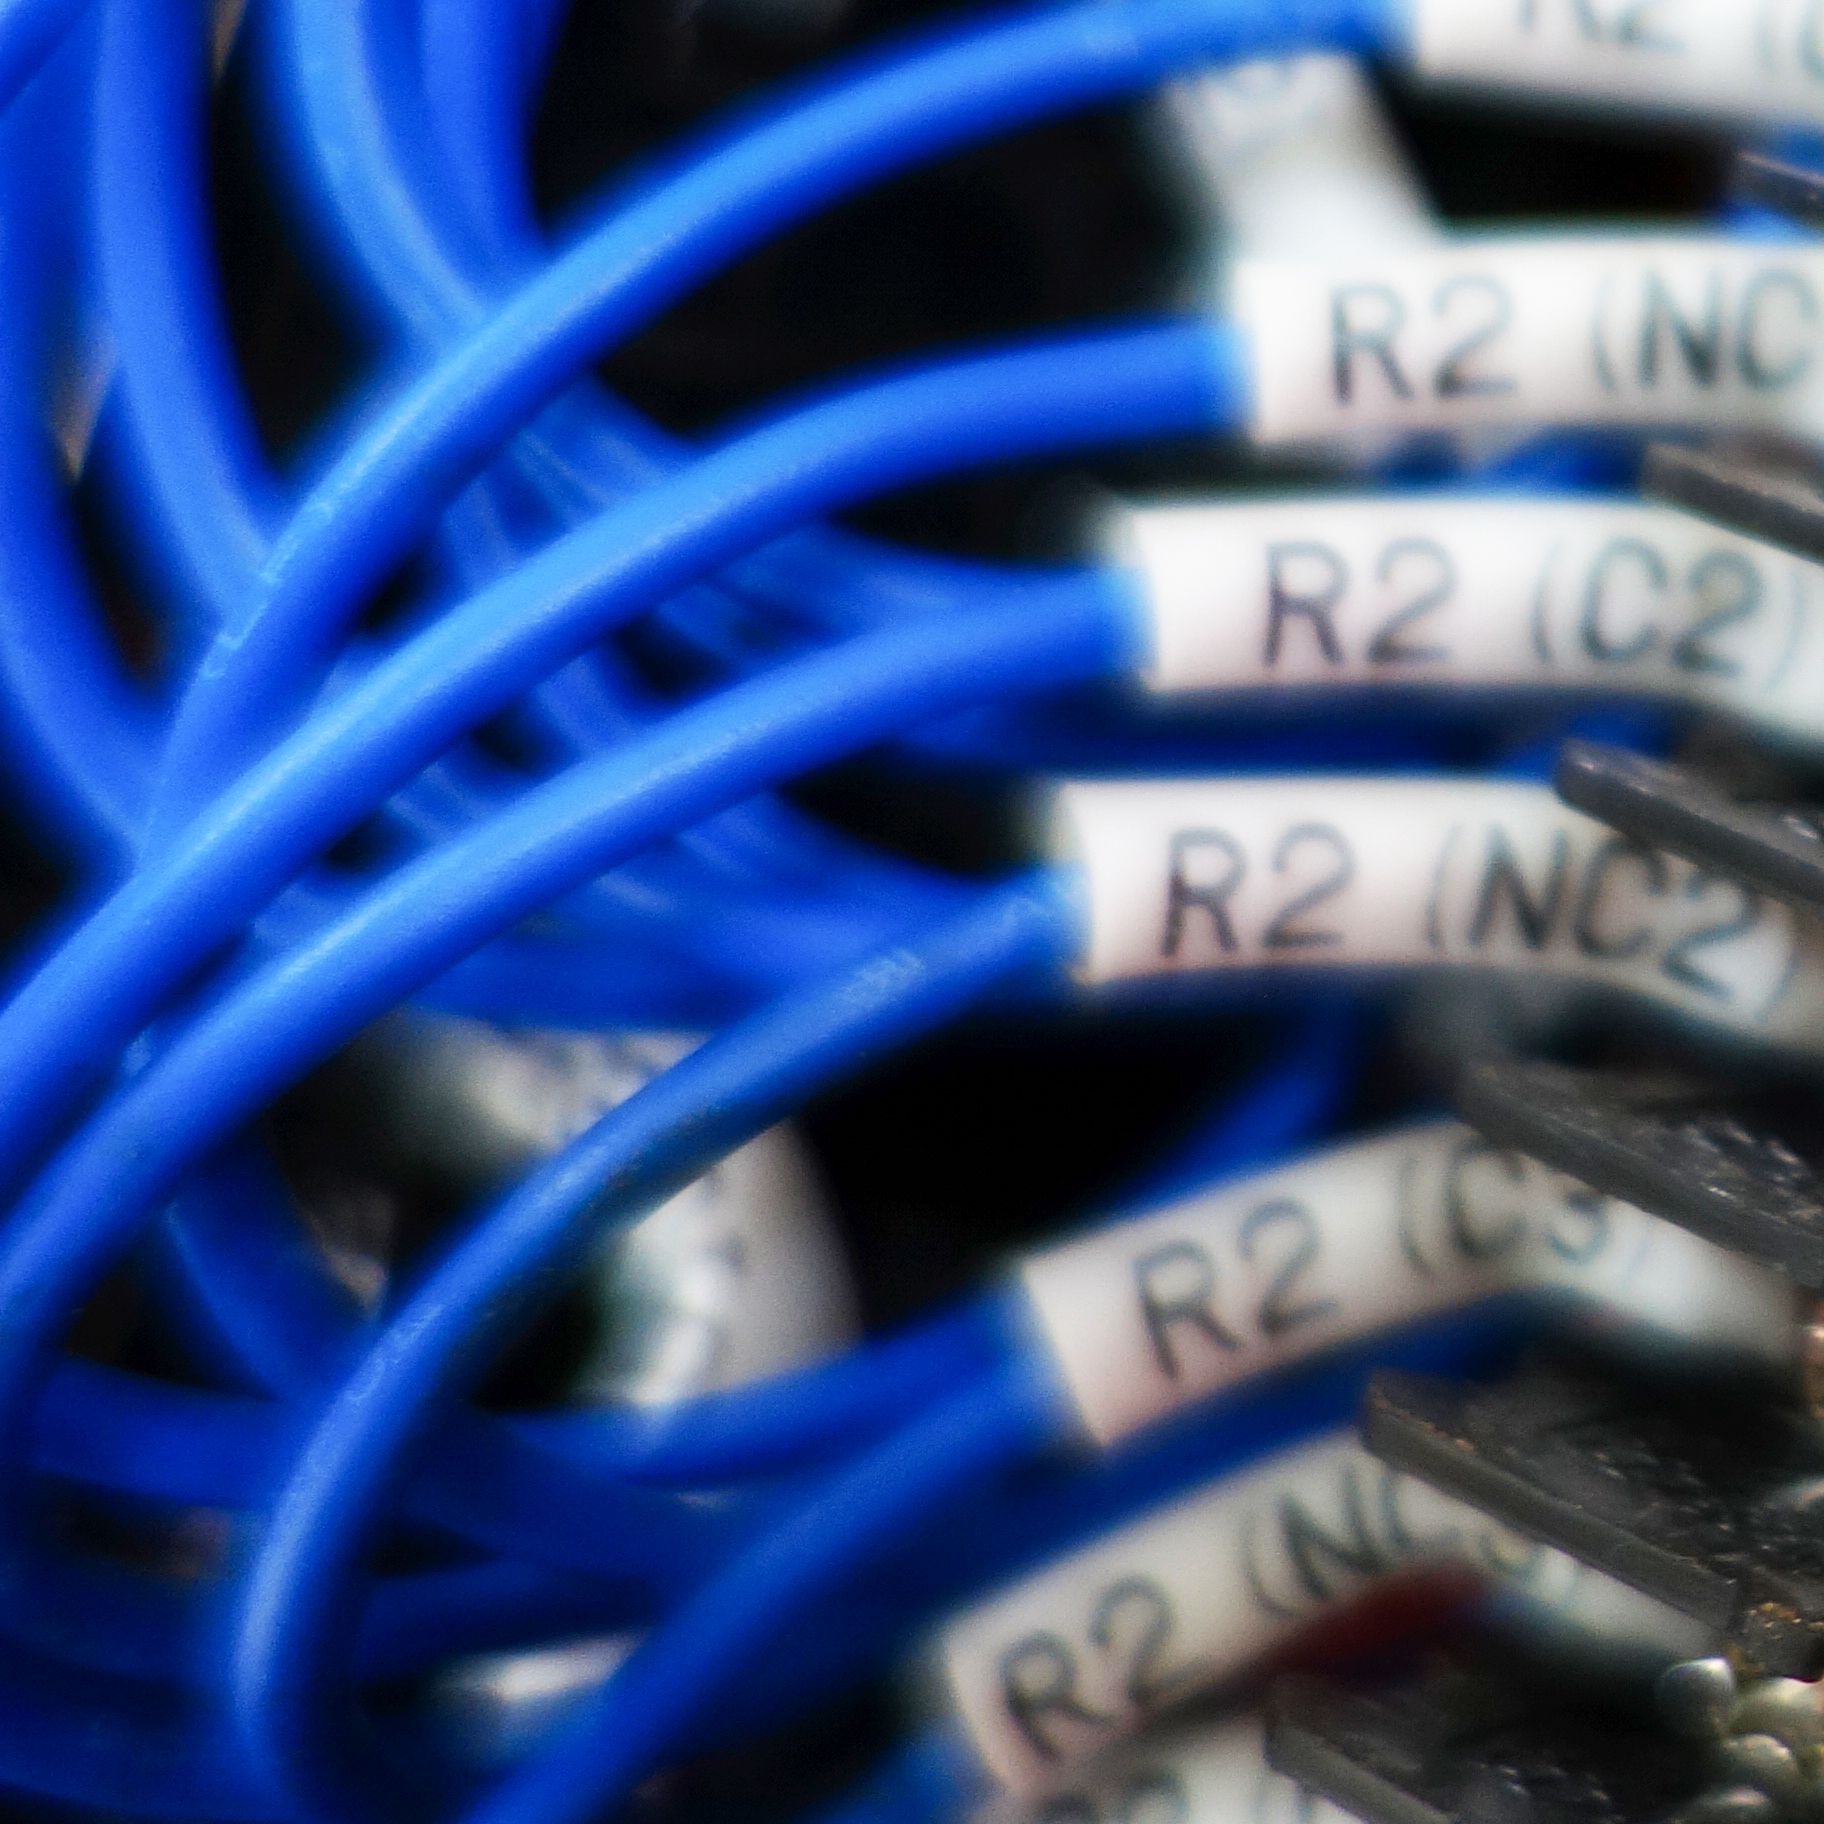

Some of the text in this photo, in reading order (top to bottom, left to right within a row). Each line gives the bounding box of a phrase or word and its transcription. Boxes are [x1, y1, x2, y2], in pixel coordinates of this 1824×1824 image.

[1328, 274, 1516, 406] R2
[1259, 536, 1812, 692] R2 (C2)
[1158, 819, 1798, 1026] R2 (NC2)
[1126, 1195, 1342, 1382] R2
[996, 1576, 1215, 1764] R2
